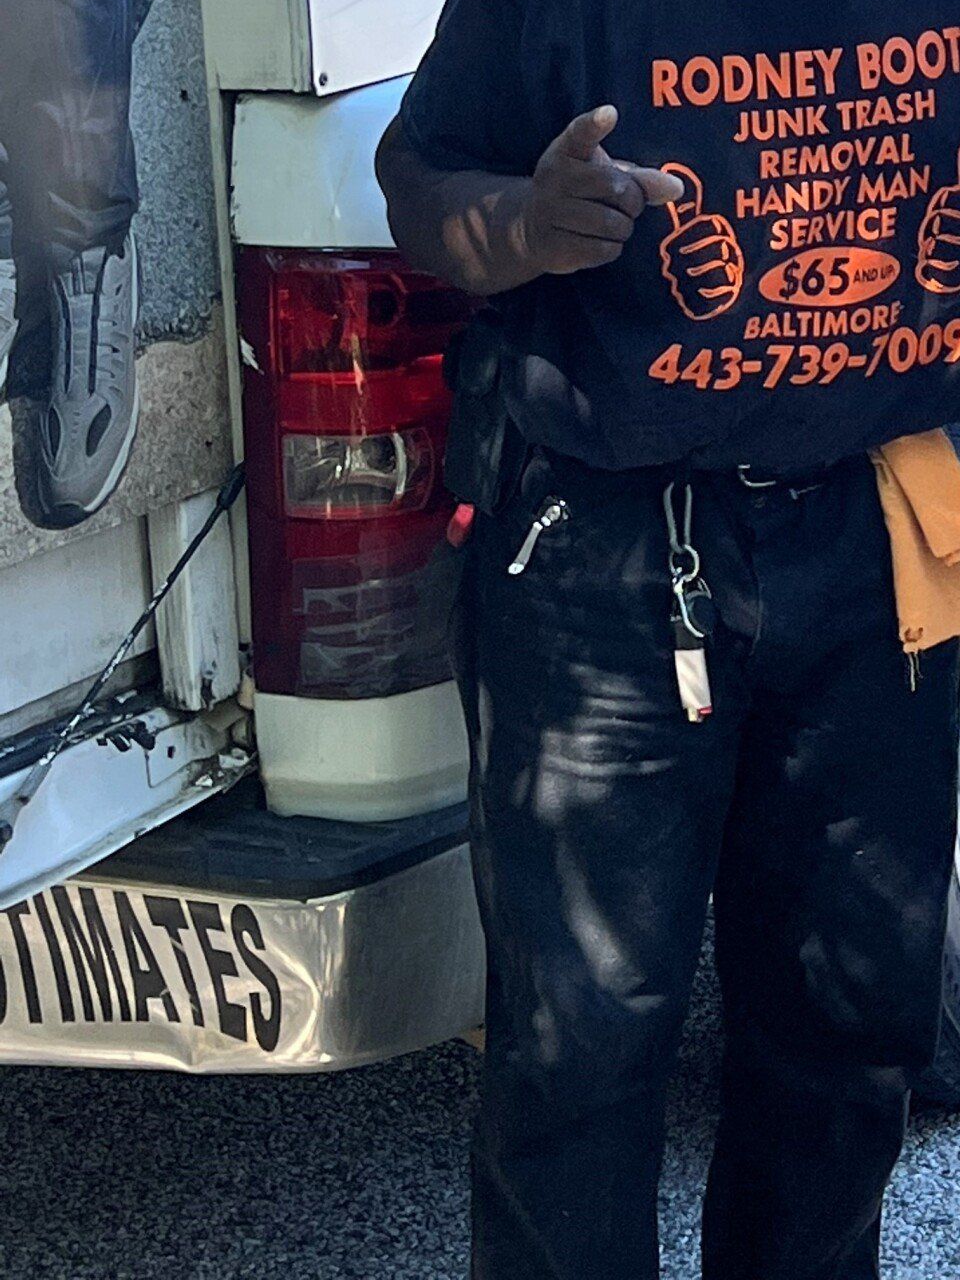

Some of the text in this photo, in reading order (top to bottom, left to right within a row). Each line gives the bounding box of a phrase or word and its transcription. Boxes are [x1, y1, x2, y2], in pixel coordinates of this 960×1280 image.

[652, 47, 844, 108] RODNEY
[733, 89, 936, 143] JUNK TRASH
[759, 133, 916, 180] REMOVAL
[736, 165, 931, 219] HANDY MAN
[770, 207, 898, 251] SERVICE
[779, 257, 850, 300] $65
[744, 300, 904, 340] BALTIMORE
[0, 885, 282, 1053] TIMATES
